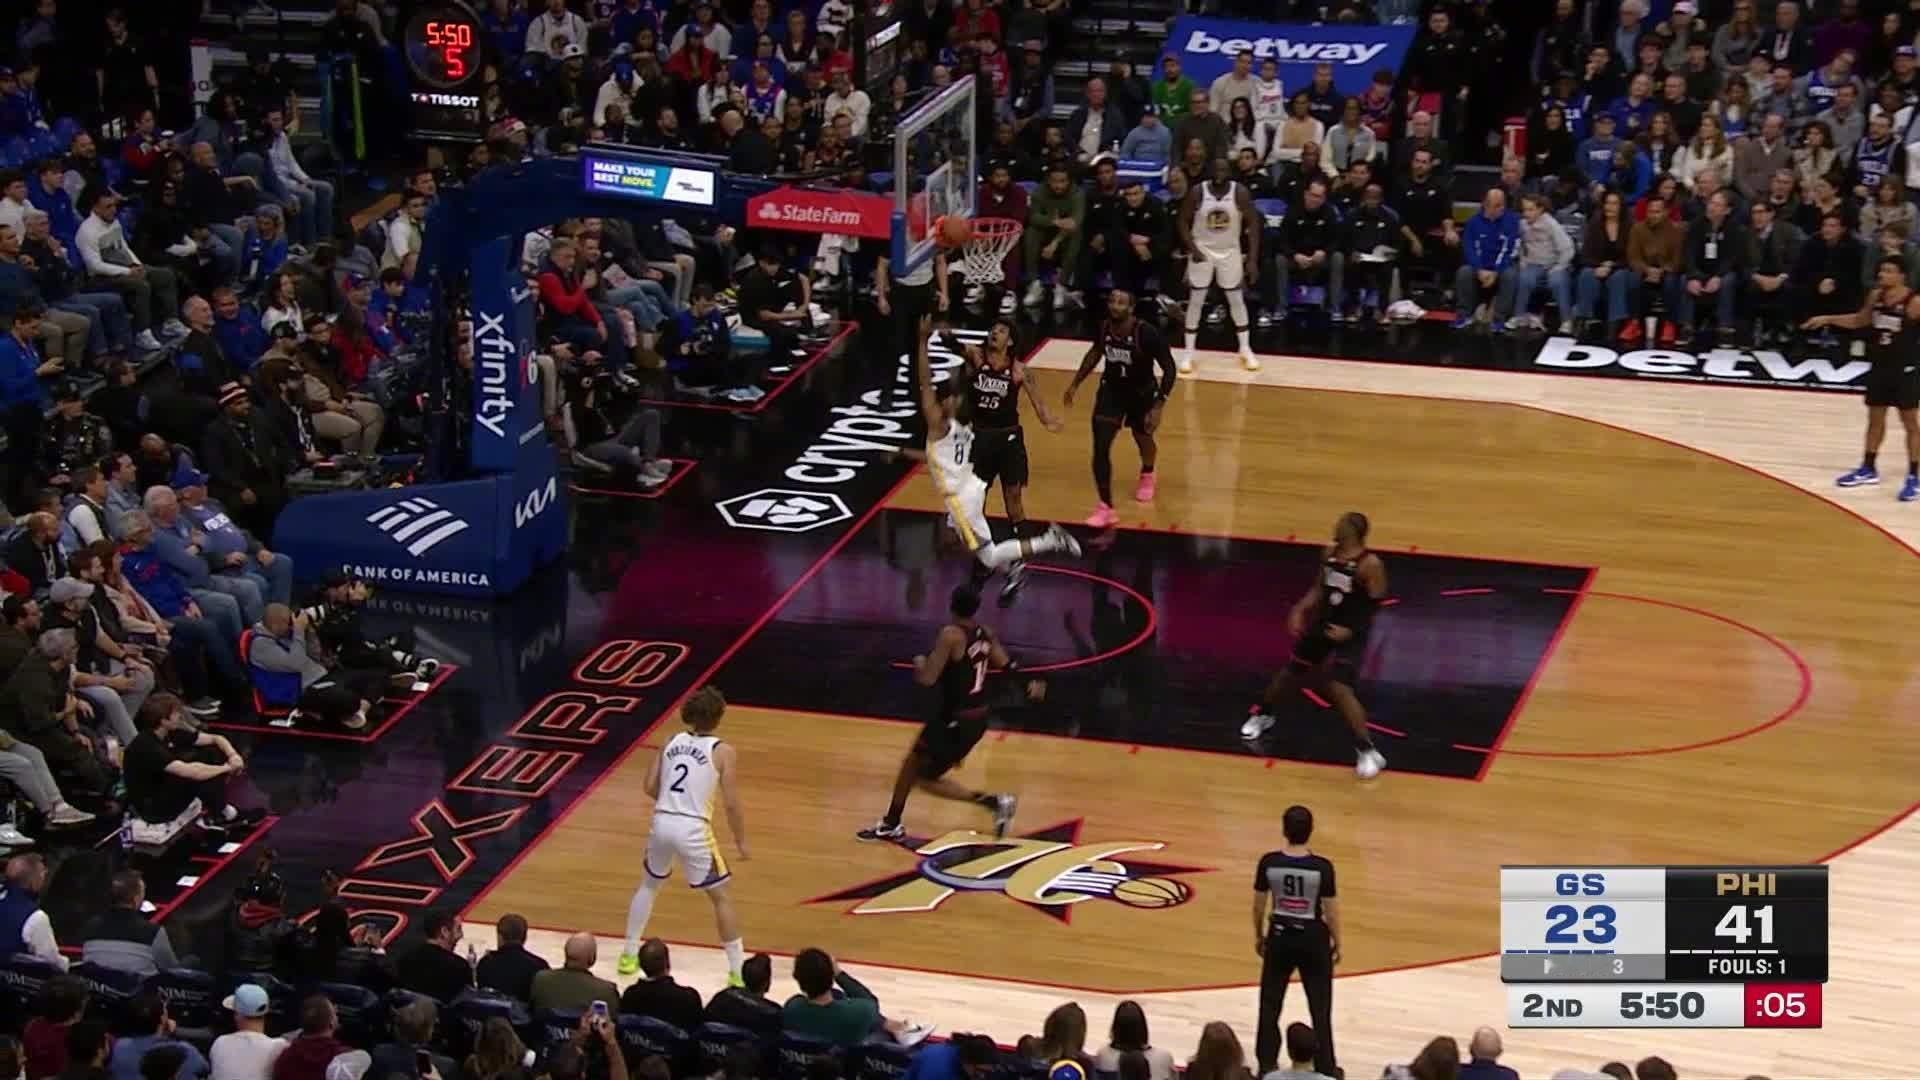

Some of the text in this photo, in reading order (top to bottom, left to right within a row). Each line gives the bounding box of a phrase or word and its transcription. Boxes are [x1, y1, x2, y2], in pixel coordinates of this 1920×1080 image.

[426, 22, 471, 46] 5:50
[1184, 31, 1388, 65] betway
[446, 47, 464, 76] 5
[593, 162, 656, 178] MAKE YOUR
[593, 172, 619, 183] BEST
[475, 311, 515, 438] xfinity
[978, 396, 1000, 409] 25
[392, 568, 412, 581] OF
[415, 569, 489, 586] AMERICA
[670, 763, 688, 793] 2
[1283, 874, 1304, 897] 91
